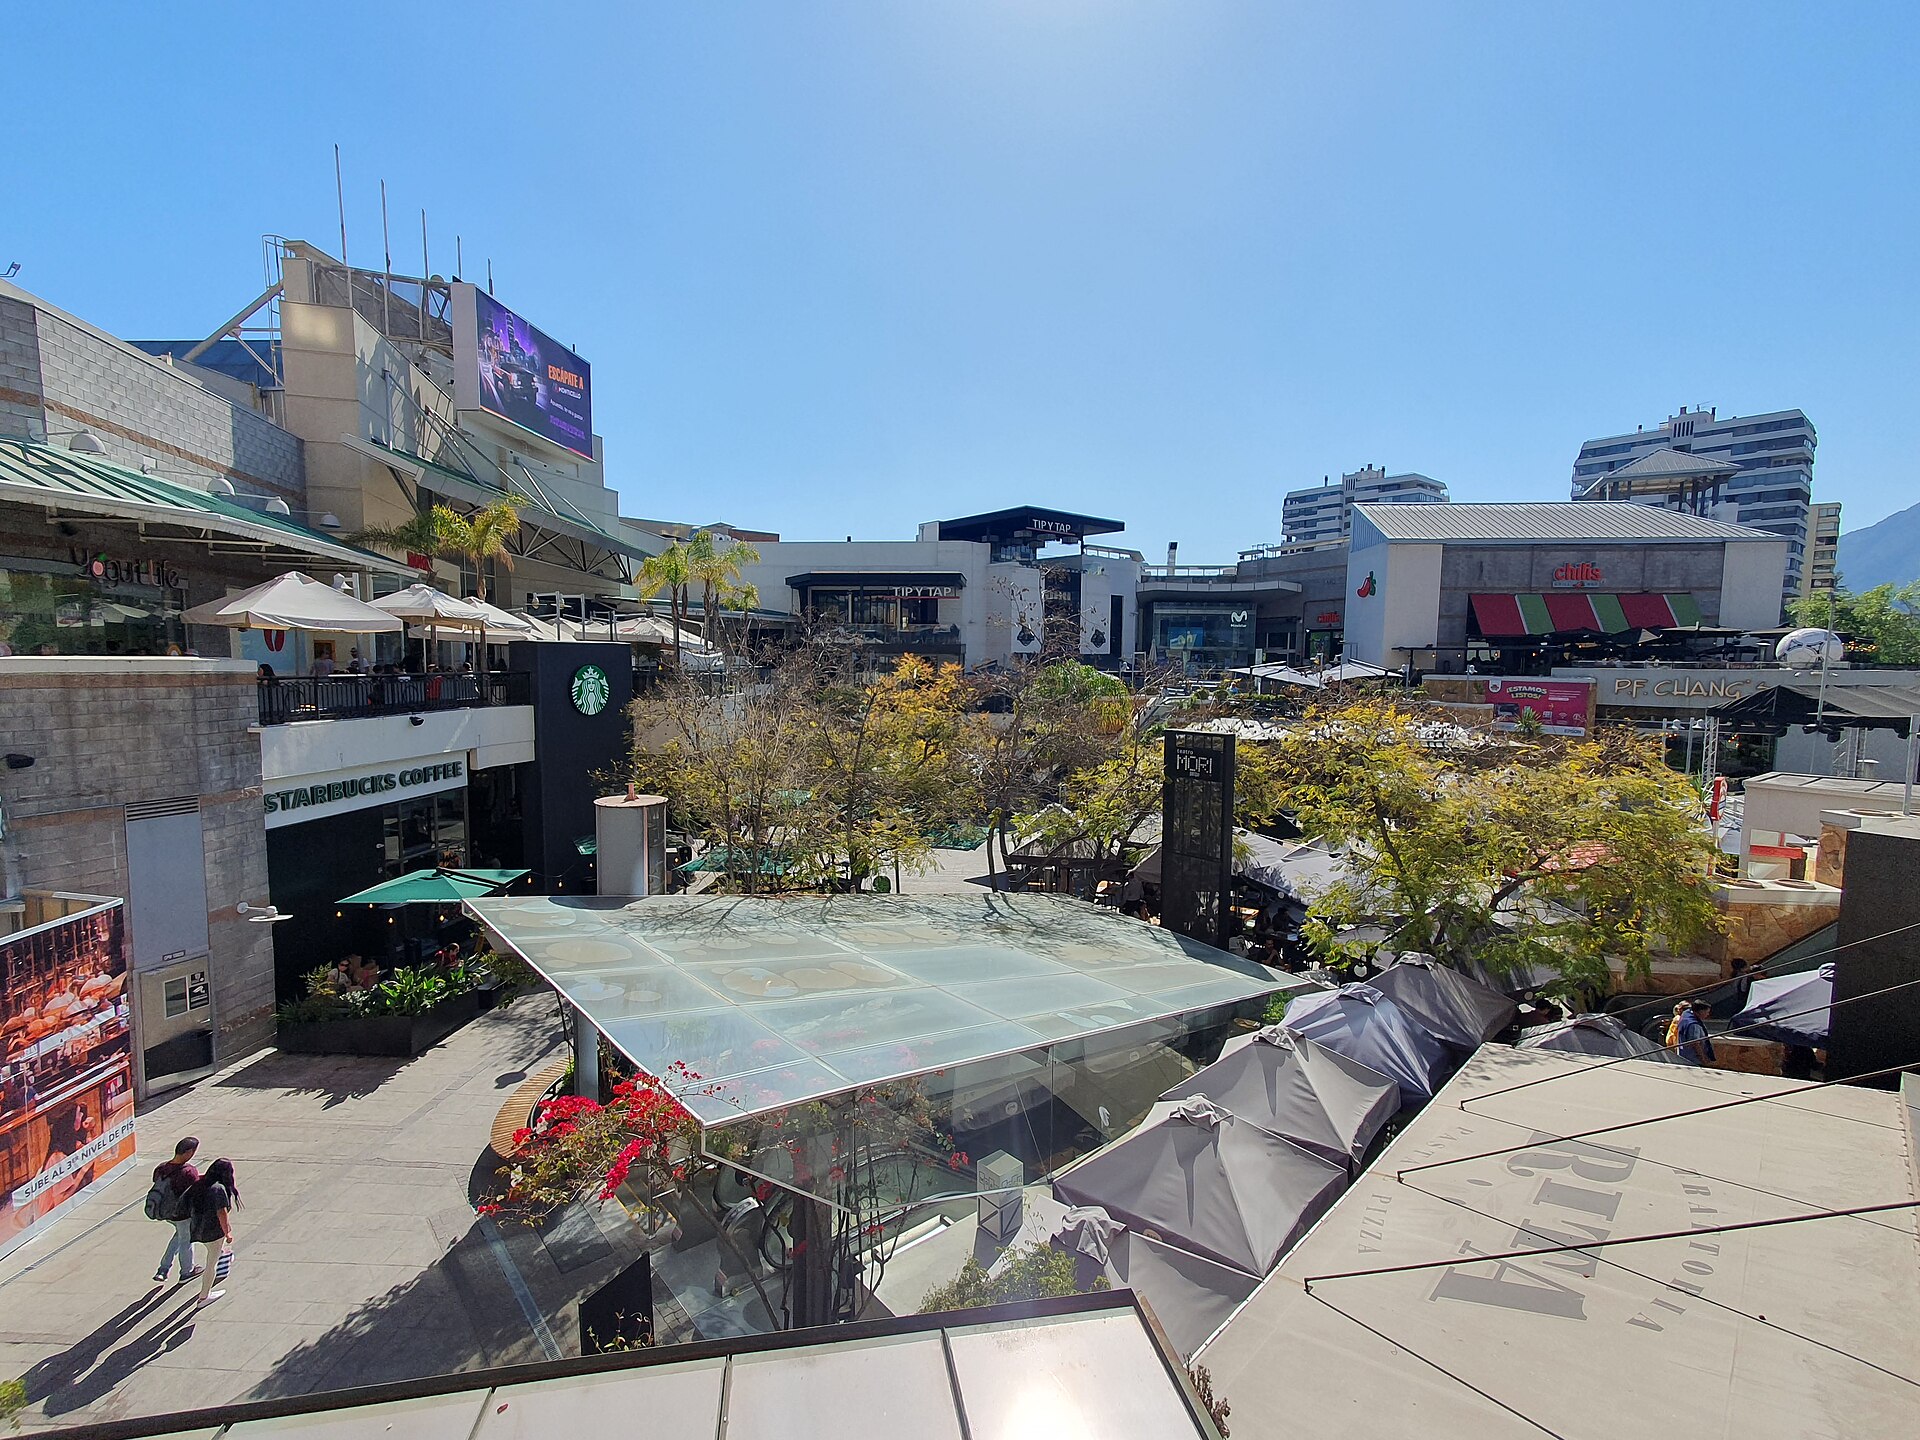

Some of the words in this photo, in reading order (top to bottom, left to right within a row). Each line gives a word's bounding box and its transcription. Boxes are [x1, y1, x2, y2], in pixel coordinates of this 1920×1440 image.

[548, 365, 578, 388] ESCÁPATE
[579, 376, 584, 390] A
[1033, 519, 1047, 530] TIP
[1047, 521, 1054, 531] Y
[1055, 522, 1071, 533] TAP
[893, 586, 913, 597] TIP
[914, 586, 923, 597] Y
[927, 586, 952, 597] TAP
[1614, 678, 1648, 698] P.F.
[1176, 754, 1213, 774] MORI
[263, 773, 397, 814] STARBUCKS
[399, 760, 463, 787] COFFEE
[24, 1175, 49, 1198] SUBE
[51, 1166, 65, 1180] AL
[81, 1141, 107, 1160] NIVEL
[108, 1129, 120, 1143] DE
[1400, 1126, 1476, 1165] PASTA
[1358, 1193, 1393, 1254] PIZZA
[1429, 1129, 1642, 1321] RITA
[1626, 1168, 1721, 1333] TRATTORIA
